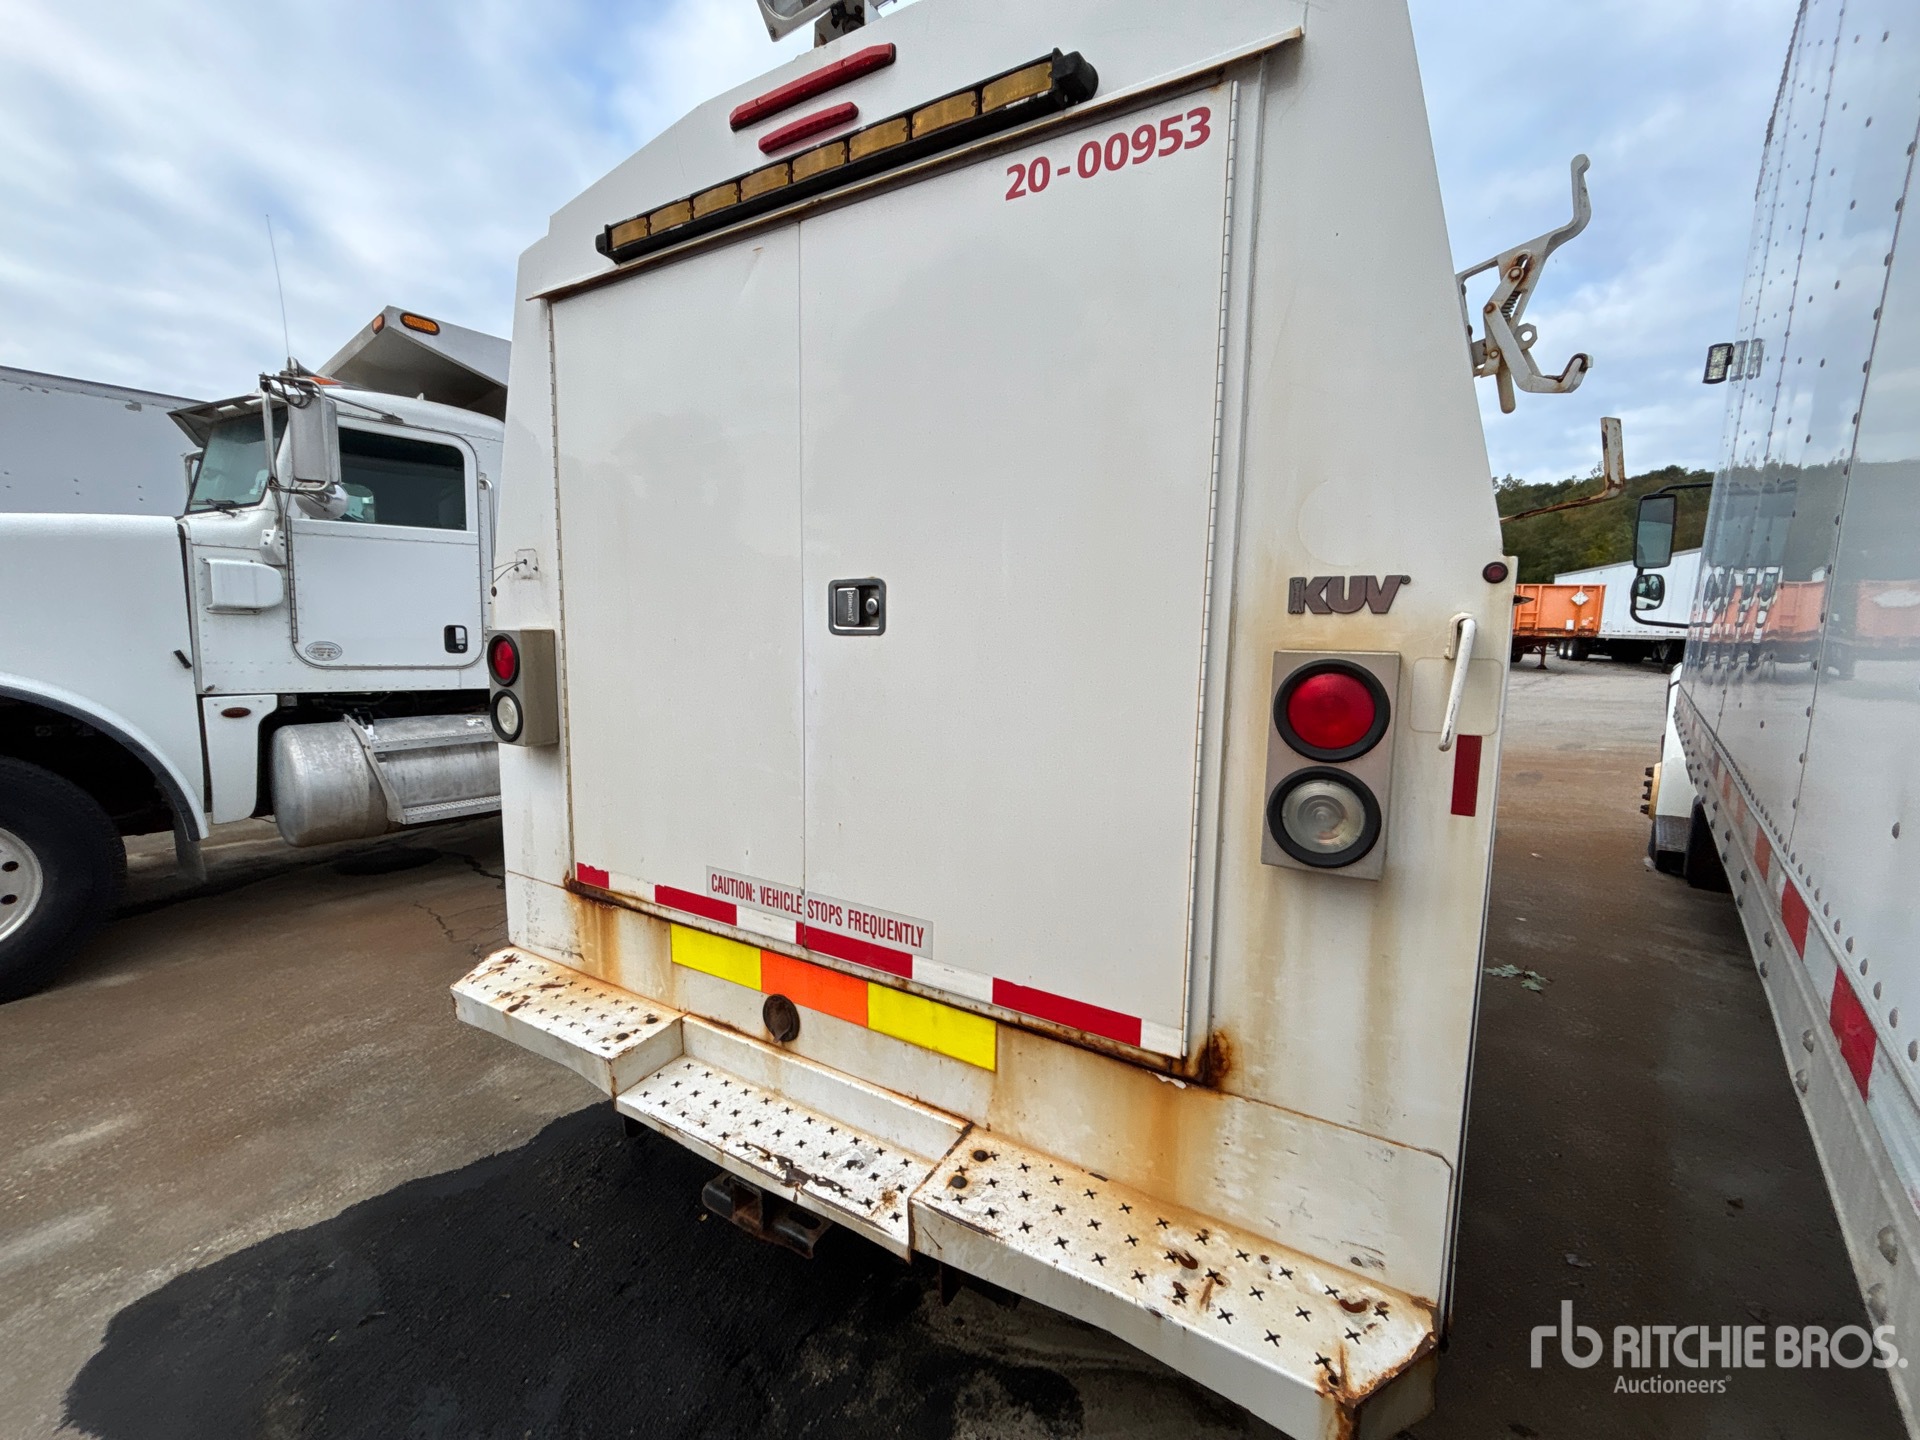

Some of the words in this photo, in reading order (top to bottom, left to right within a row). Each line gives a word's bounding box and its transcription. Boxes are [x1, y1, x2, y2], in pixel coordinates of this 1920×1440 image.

[1005, 106, 1211, 201] 20-00953
[1288, 575, 1402, 614] KUV
[711, 873, 756, 902] CAUTION:
[760, 885, 803, 915] VEHICLE
[807, 898, 843, 927] STOPS
[848, 909, 925, 949] FREQUENTLY
